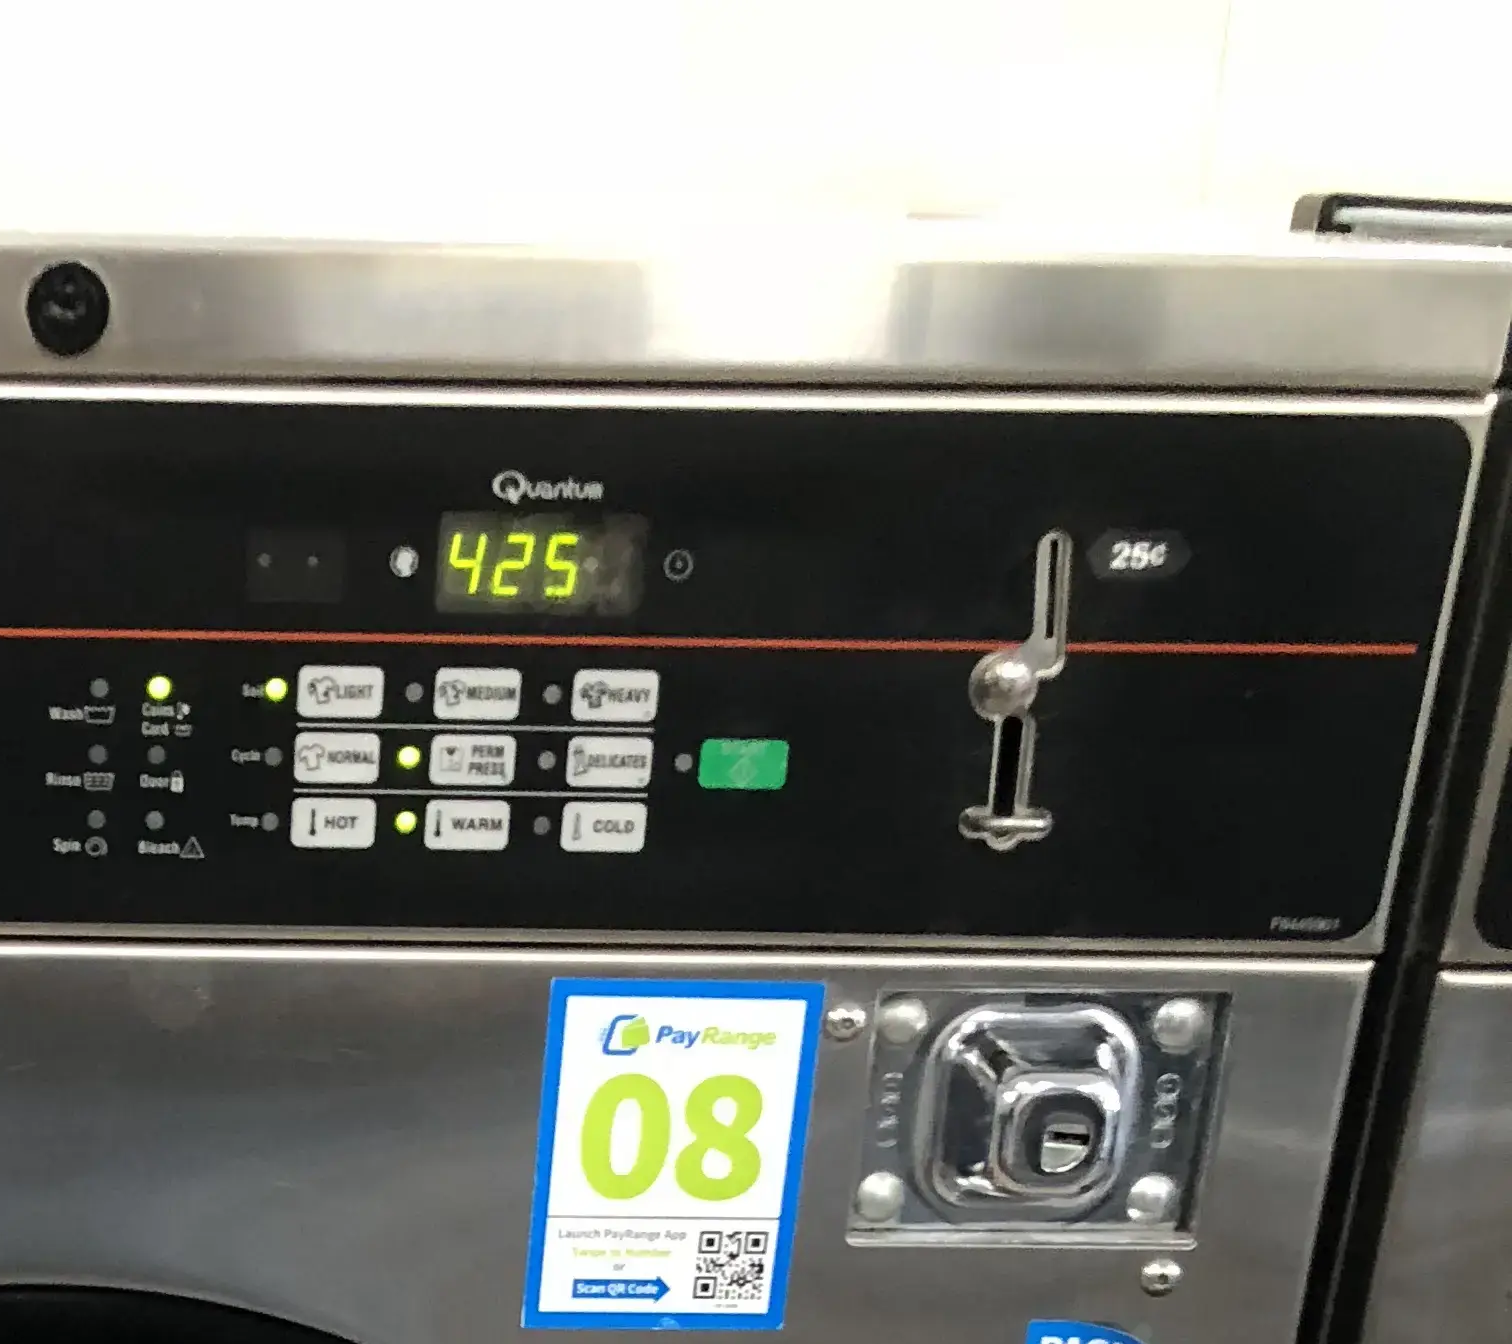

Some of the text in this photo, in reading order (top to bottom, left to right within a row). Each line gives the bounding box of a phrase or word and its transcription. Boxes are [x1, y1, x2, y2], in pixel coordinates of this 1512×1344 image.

[492, 470, 604, 503] Quantum
[1109, 540, 1169, 572] 25¢
[448, 531, 580, 598] 425
[335, 684, 373, 700] LIGHT
[466, 684, 517, 702] MEDIUM
[608, 687, 652, 703] HEAVY
[328, 748, 375, 764] NORMAL
[471, 743, 505, 759] PERM
[467, 760, 506, 777] PRESS
[587, 752, 647, 770] DELICATES
[324, 815, 359, 831] HOT
[451, 816, 503, 832] WARM
[592, 818, 635, 834] COLD
[656, 1025, 777, 1050] PayRange
[581, 1072, 763, 1201] 08
[558, 1228, 688, 1242] Launch PayRange App
[576, 1283, 660, 1296] Scan QR Code
